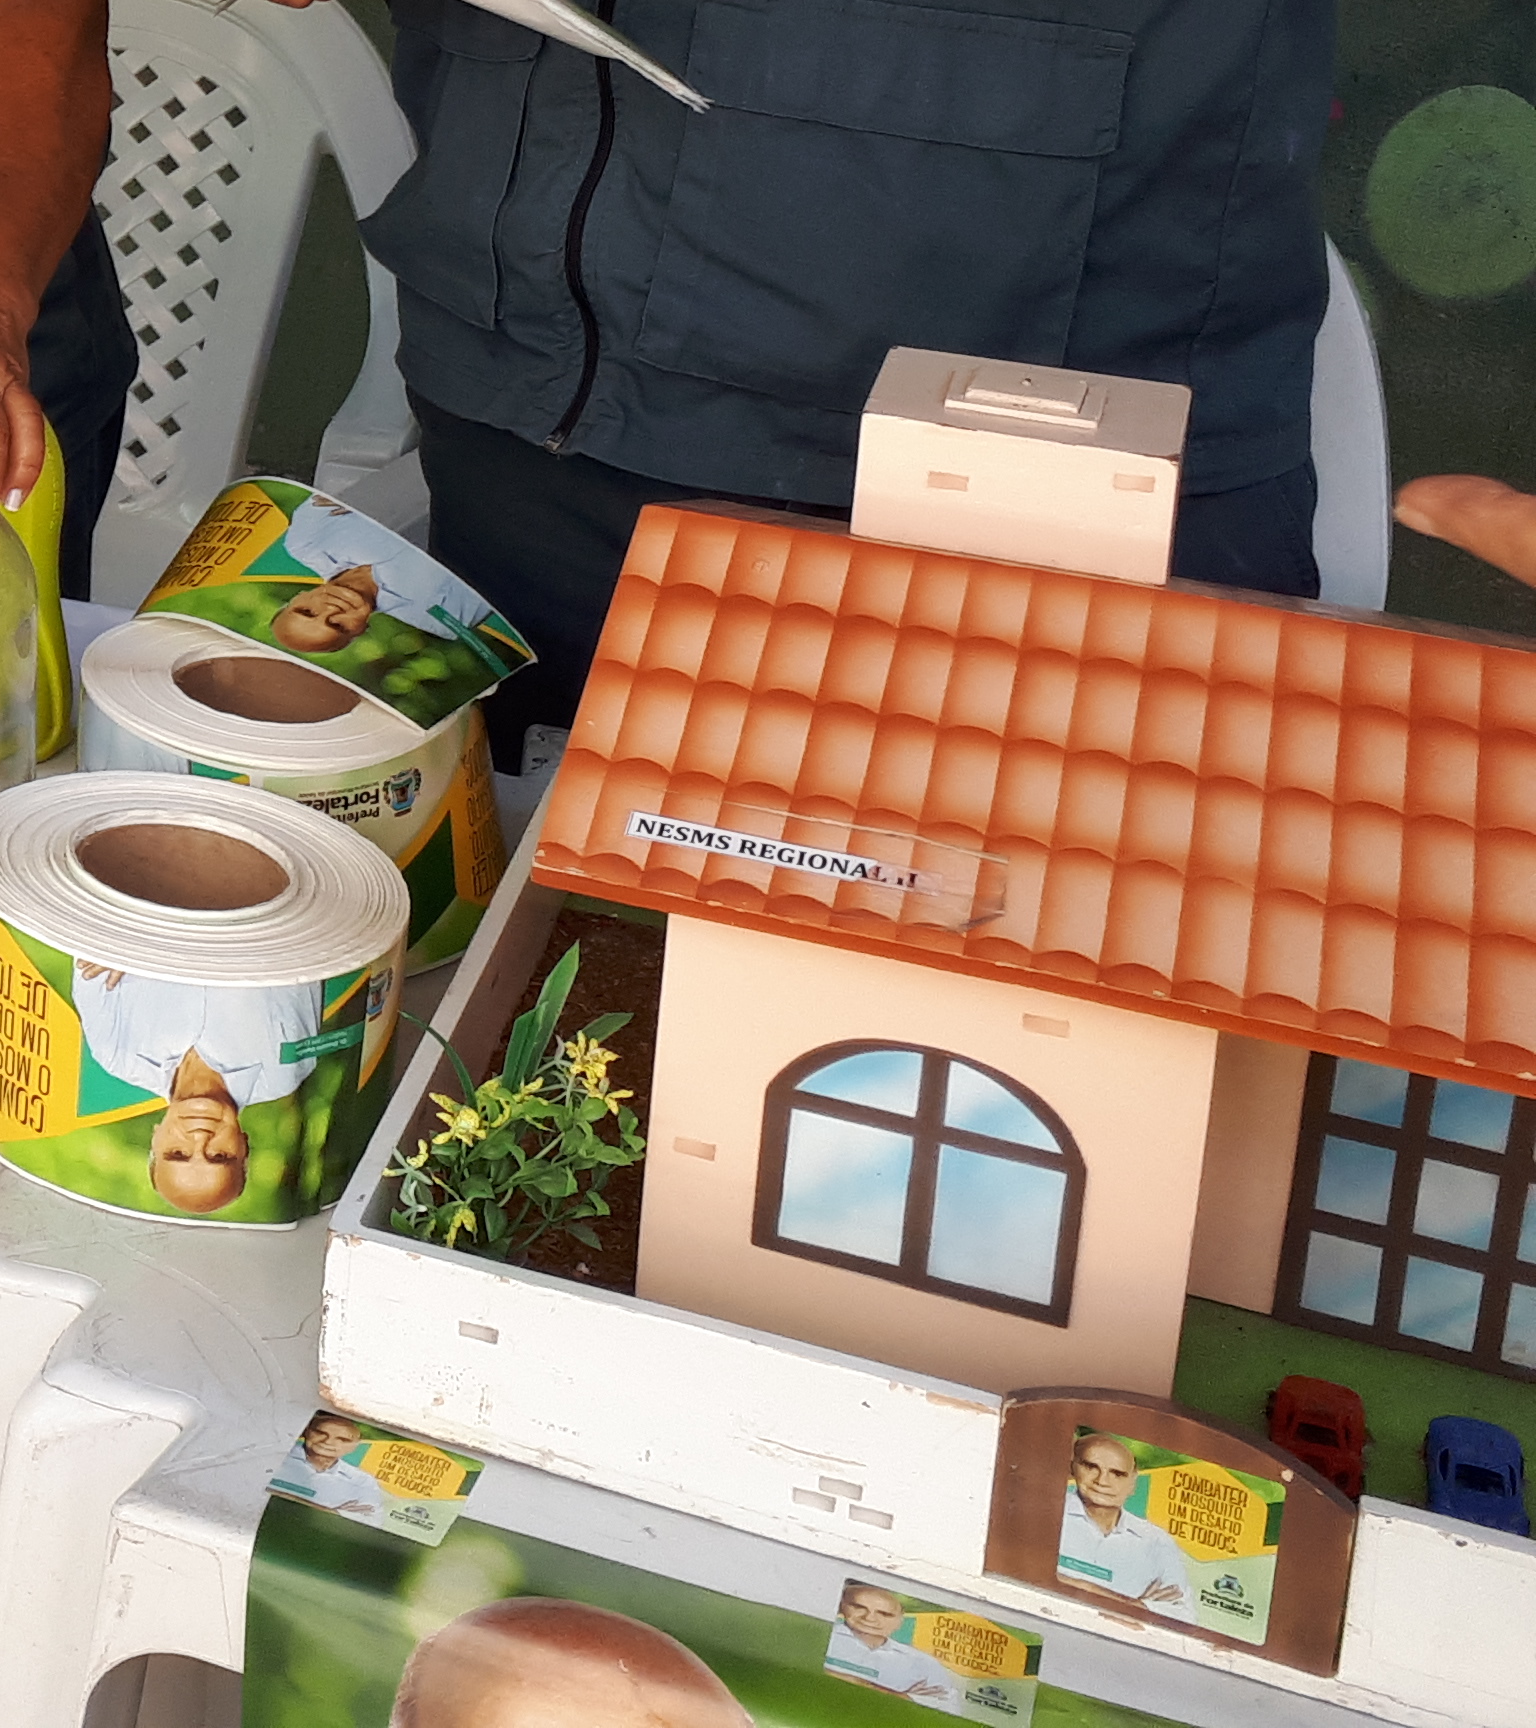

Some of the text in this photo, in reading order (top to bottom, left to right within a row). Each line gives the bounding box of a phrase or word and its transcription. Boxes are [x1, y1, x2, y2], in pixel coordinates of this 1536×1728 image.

[636, 818, 888, 882] NESMS REGIONAL
[19, 971, 49, 1020] DE
[22, 1018, 51, 1061] UM
[38, 1064, 51, 1096] O
